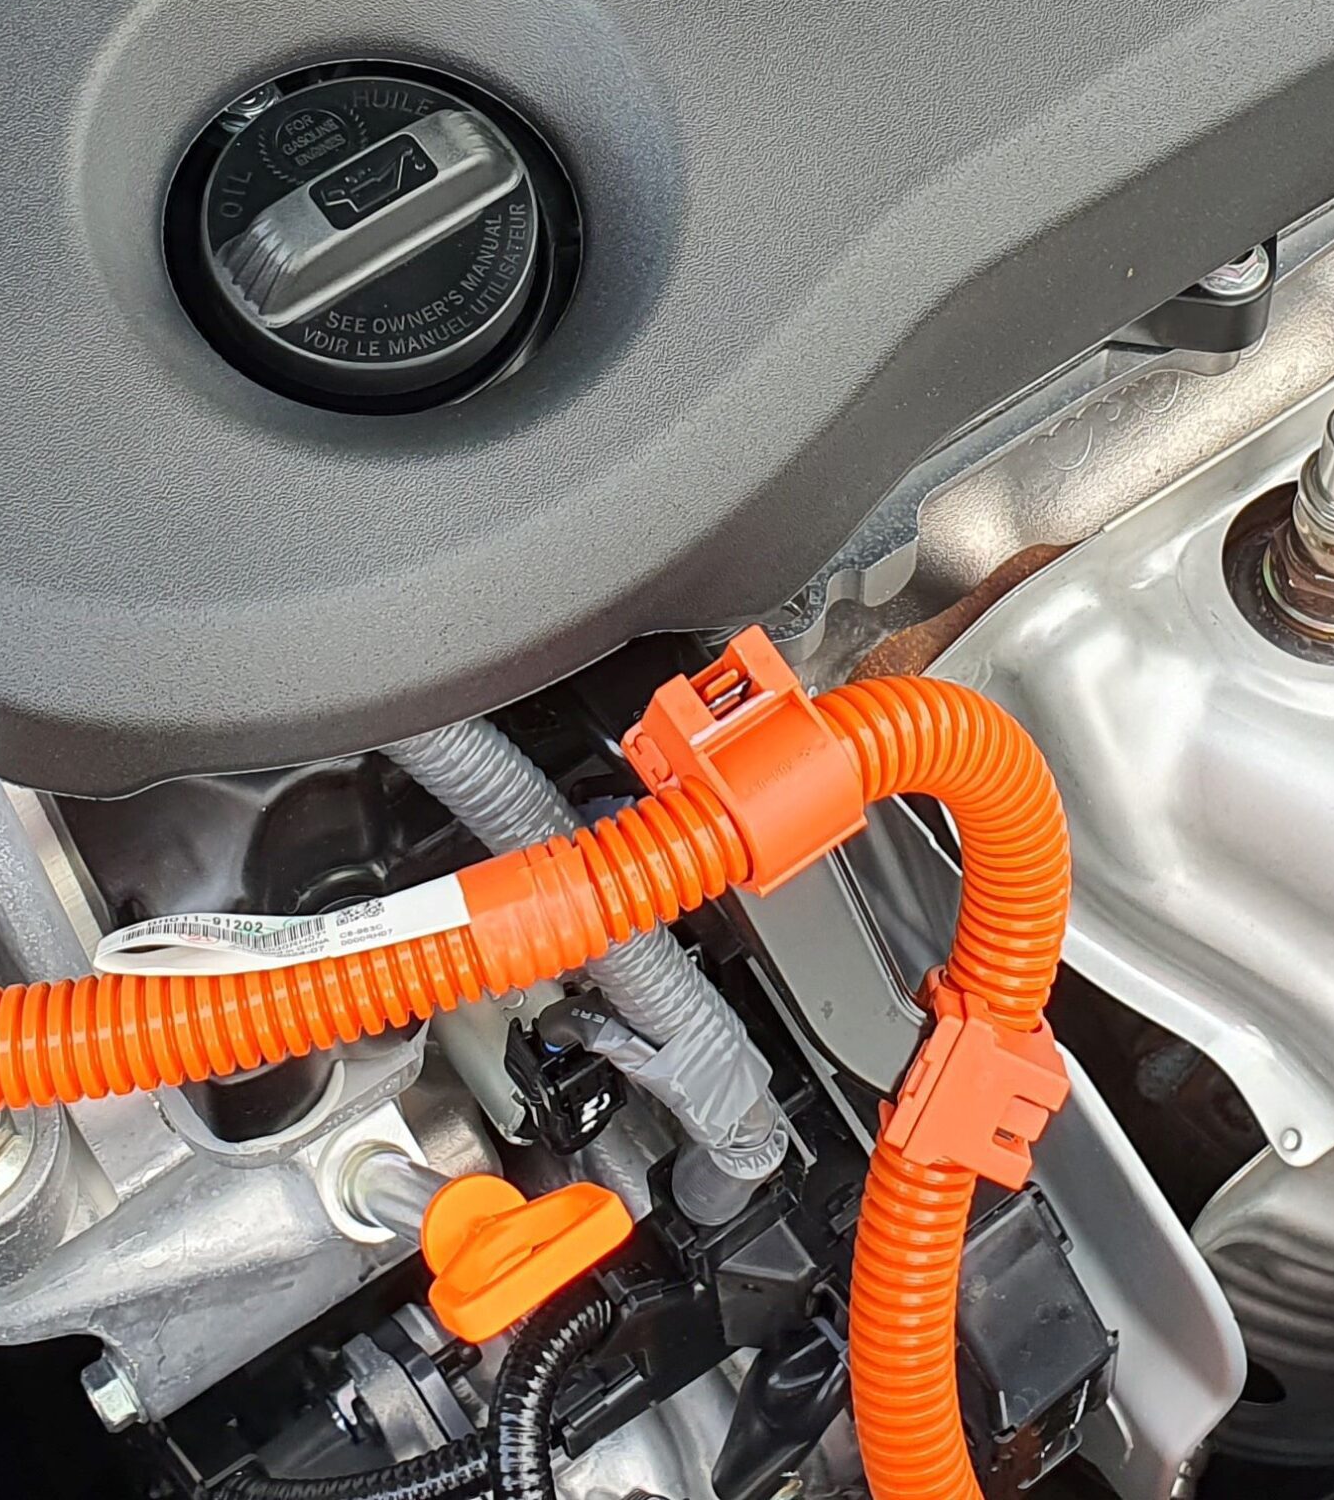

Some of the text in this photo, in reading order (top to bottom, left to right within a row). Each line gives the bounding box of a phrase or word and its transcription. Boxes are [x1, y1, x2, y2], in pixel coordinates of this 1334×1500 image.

[353, 88, 430, 117] HUILE
[283, 119, 339, 155] GASOLINE
[285, 115, 314, 135] FOR
[221, 171, 252, 218] OIL
[302, 203, 526, 357] VOIR LE MANUEL UTILISATEUR
[326, 214, 502, 335] SEE OWNER'S MANUAL
